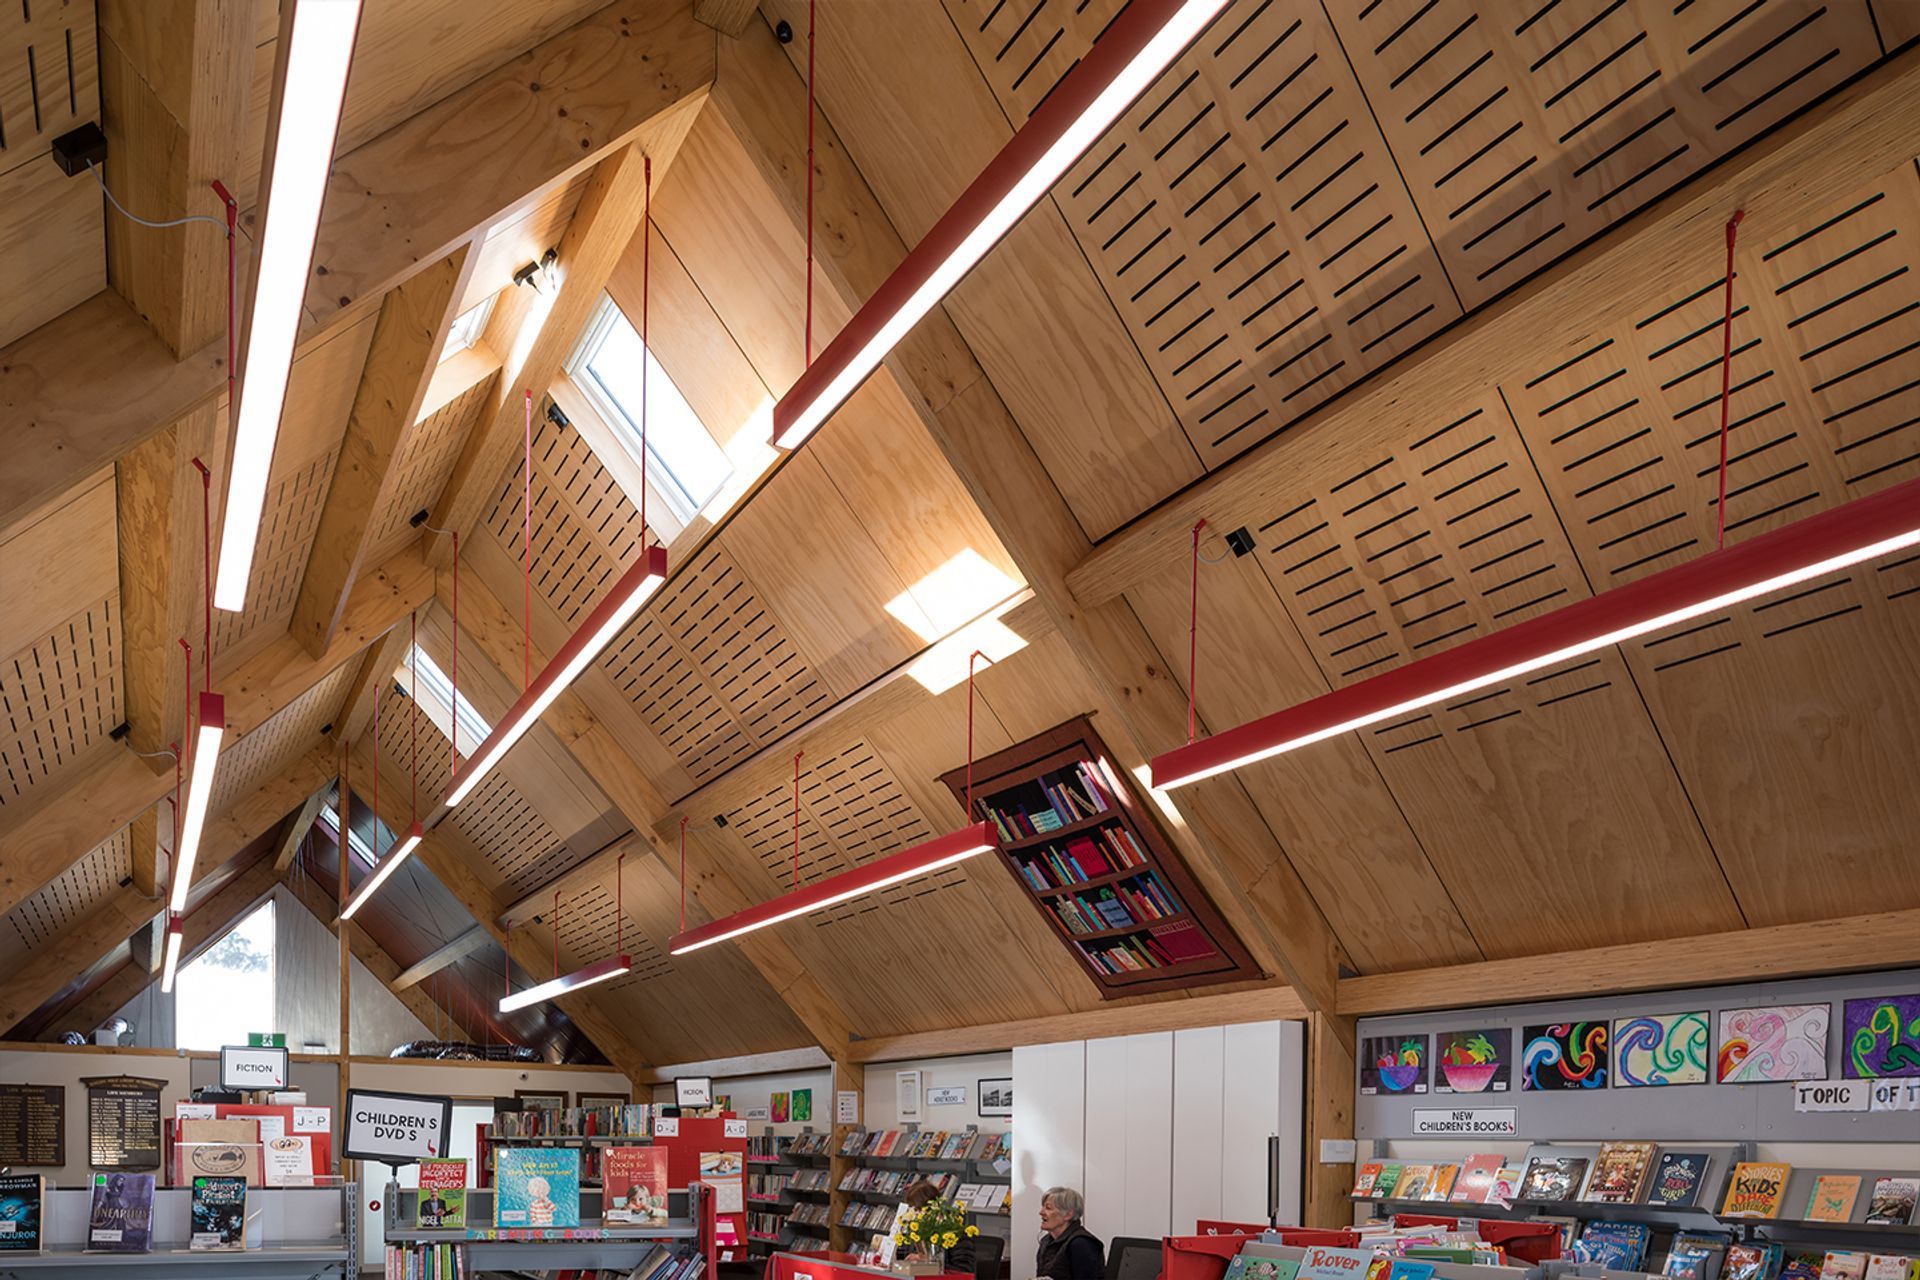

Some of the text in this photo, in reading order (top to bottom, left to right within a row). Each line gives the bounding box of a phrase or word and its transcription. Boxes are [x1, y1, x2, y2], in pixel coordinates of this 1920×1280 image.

[235, 1063, 273, 1073] FICTION
[683, 1088, 704, 1096] FICTION
[1798, 1087, 1851, 1104] TOPIC
[1875, 1086, 1900, 1103] OF
[297, 1115, 305, 1126] J
[317, 1115, 327, 1126] P
[355, 1111, 426, 1129] CHILDREN
[1451, 1111, 1474, 1121] NEW
[725, 1125, 733, 1134] A
[1419, 1121, 1508, 1132] CHILDREN'S BOOKS
[374, 1126, 406, 1140] DVD
[610, 1160, 634, 1169] foods
[610, 1168, 629, 1177] kids
[1741, 1166, 1784, 1182] STORIES
[1736, 1177, 1780, 1197] KIDS
[466, 1228, 610, 1240] PARENTING BOOKS
[1309, 1249, 1361, 1271] Rover
